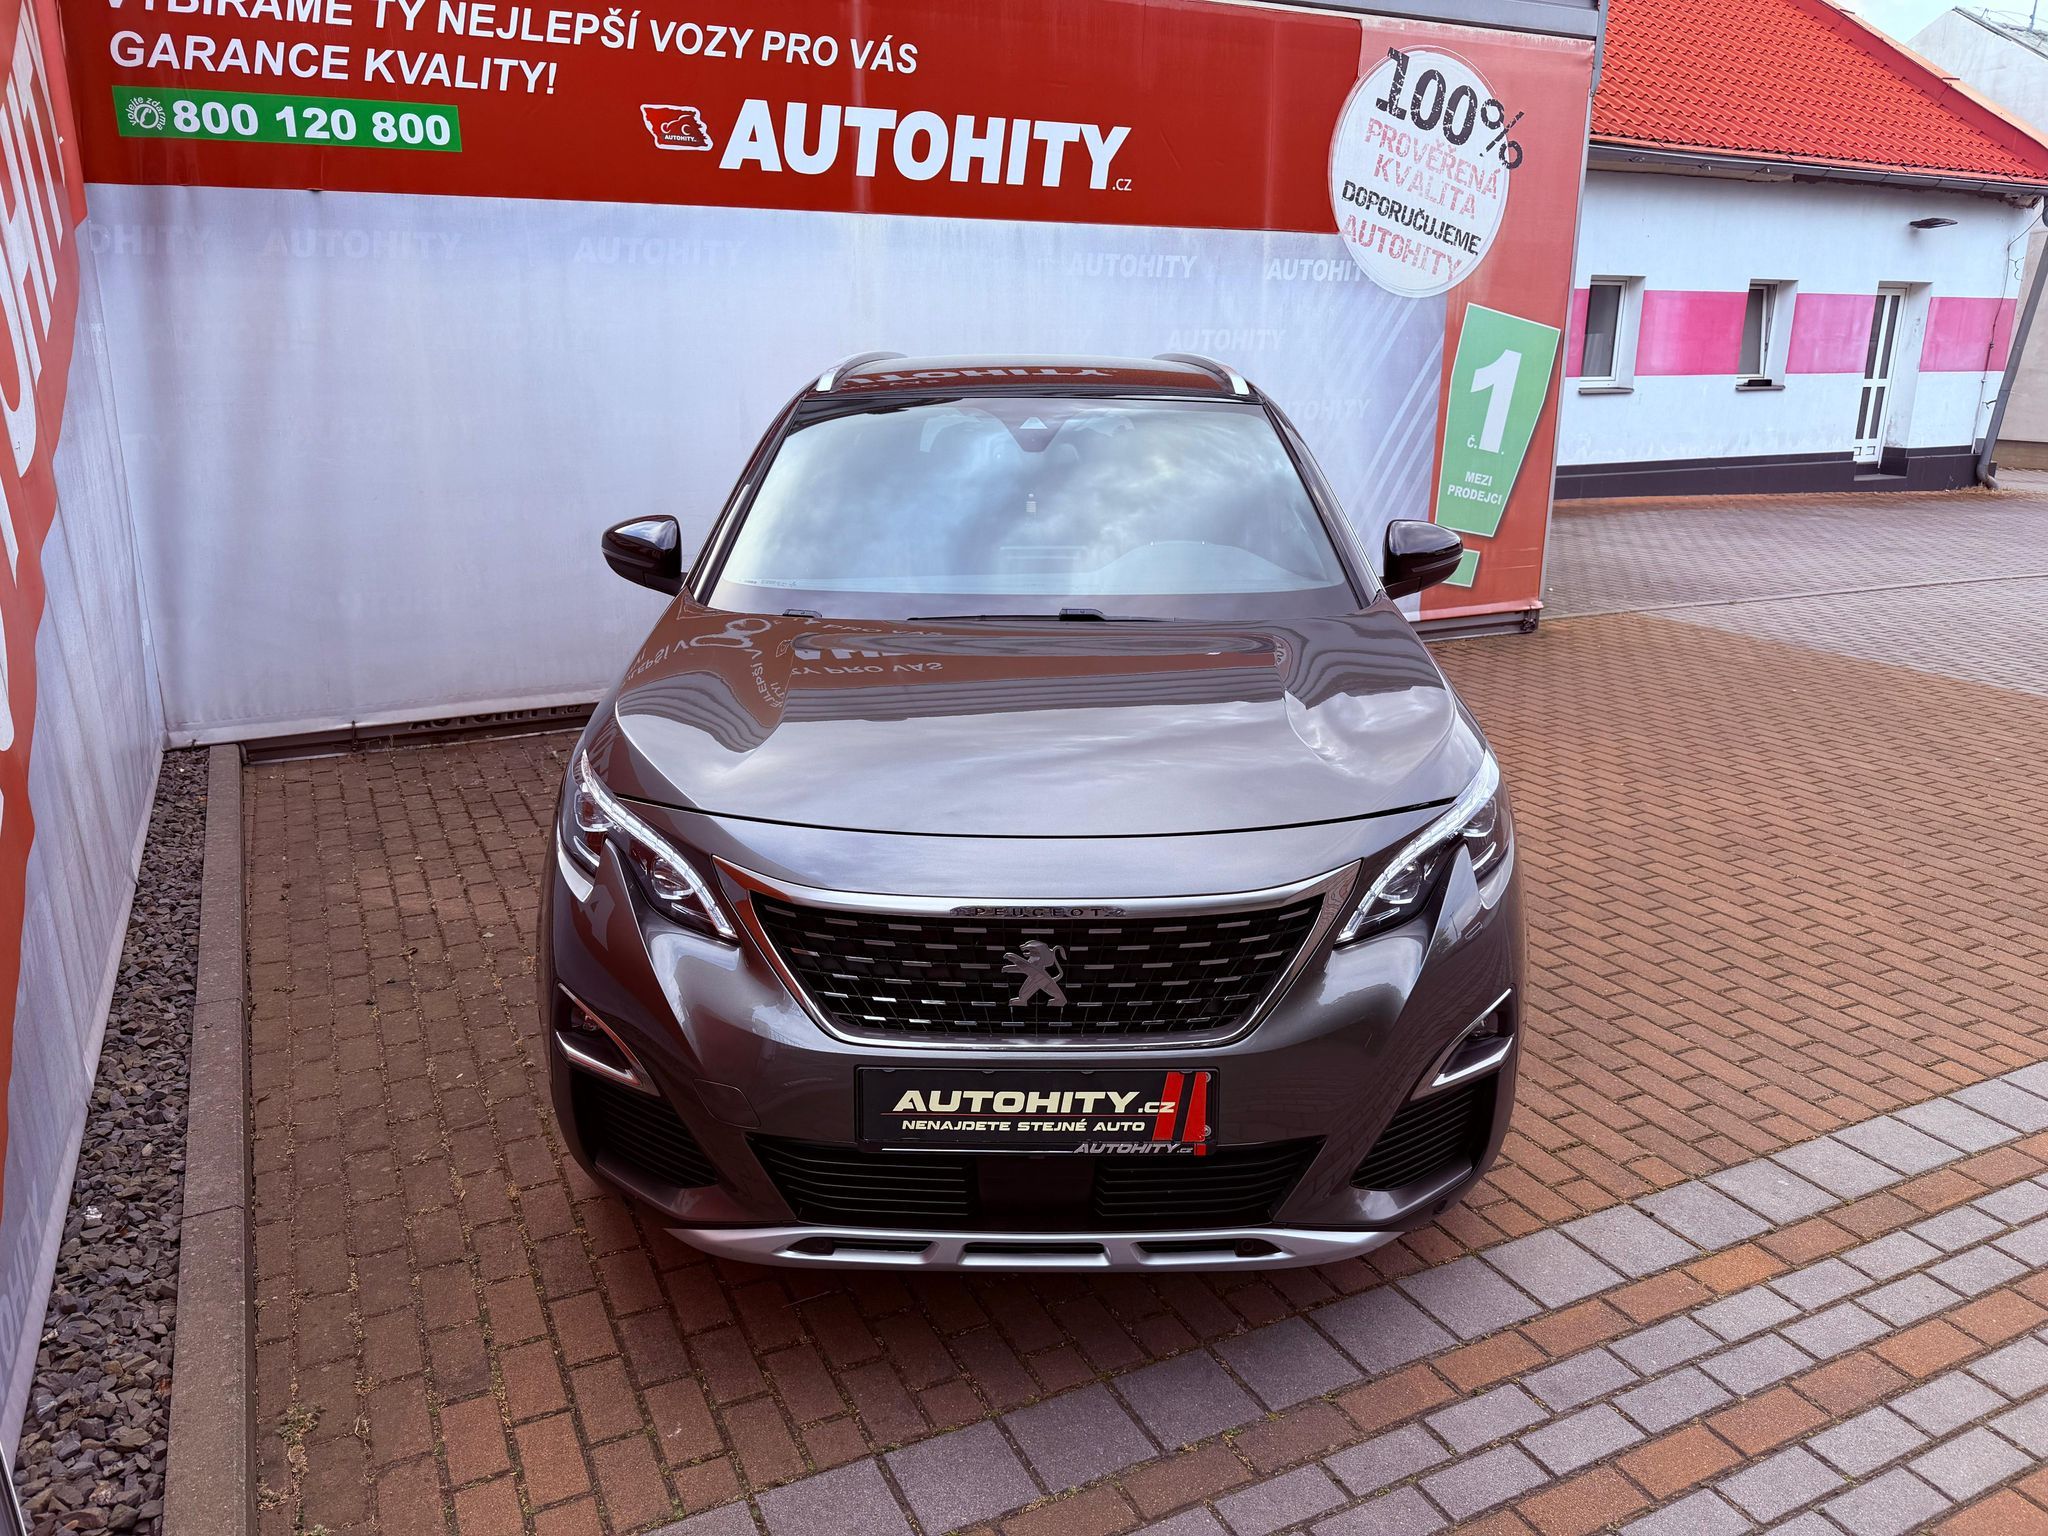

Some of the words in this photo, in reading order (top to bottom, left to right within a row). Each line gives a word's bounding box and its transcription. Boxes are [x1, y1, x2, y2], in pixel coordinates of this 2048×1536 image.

[109, 30, 350, 80] GARANCE
[364, 48, 558, 95] KVALITY!
[436, 0, 641, 50] NEJLEPŠÍ
[649, 19, 755, 59] VOZY
[761, 30, 839, 67] PRO
[849, 34, 919, 74] VÁS
[172, 100, 259, 135] 800
[275, 105, 357, 141] 120
[371, 111, 451, 146] 800
[1375, 46, 1525, 170] 100%
[1364, 117, 1501, 199] PROVĚŘENÁ
[1373, 153, 1477, 220] KVALITA
[1341, 180, 1482, 256] DOPORUČUJEME
[1343, 214, 1464, 282] AUTOHITY
[1266, 257, 1375, 282] AUTOHIT
[1447, 484, 1503, 506] PRODEJCI
[1464, 471, 1493, 487] MEZI
[974, 907, 1102, 917] PEUGEOT
[902, 1119, 1012, 1132] NENAJDETE
[1017, 1118, 1087, 1132] STEJNÉ
[1092, 1121, 1146, 1132] AUTO
